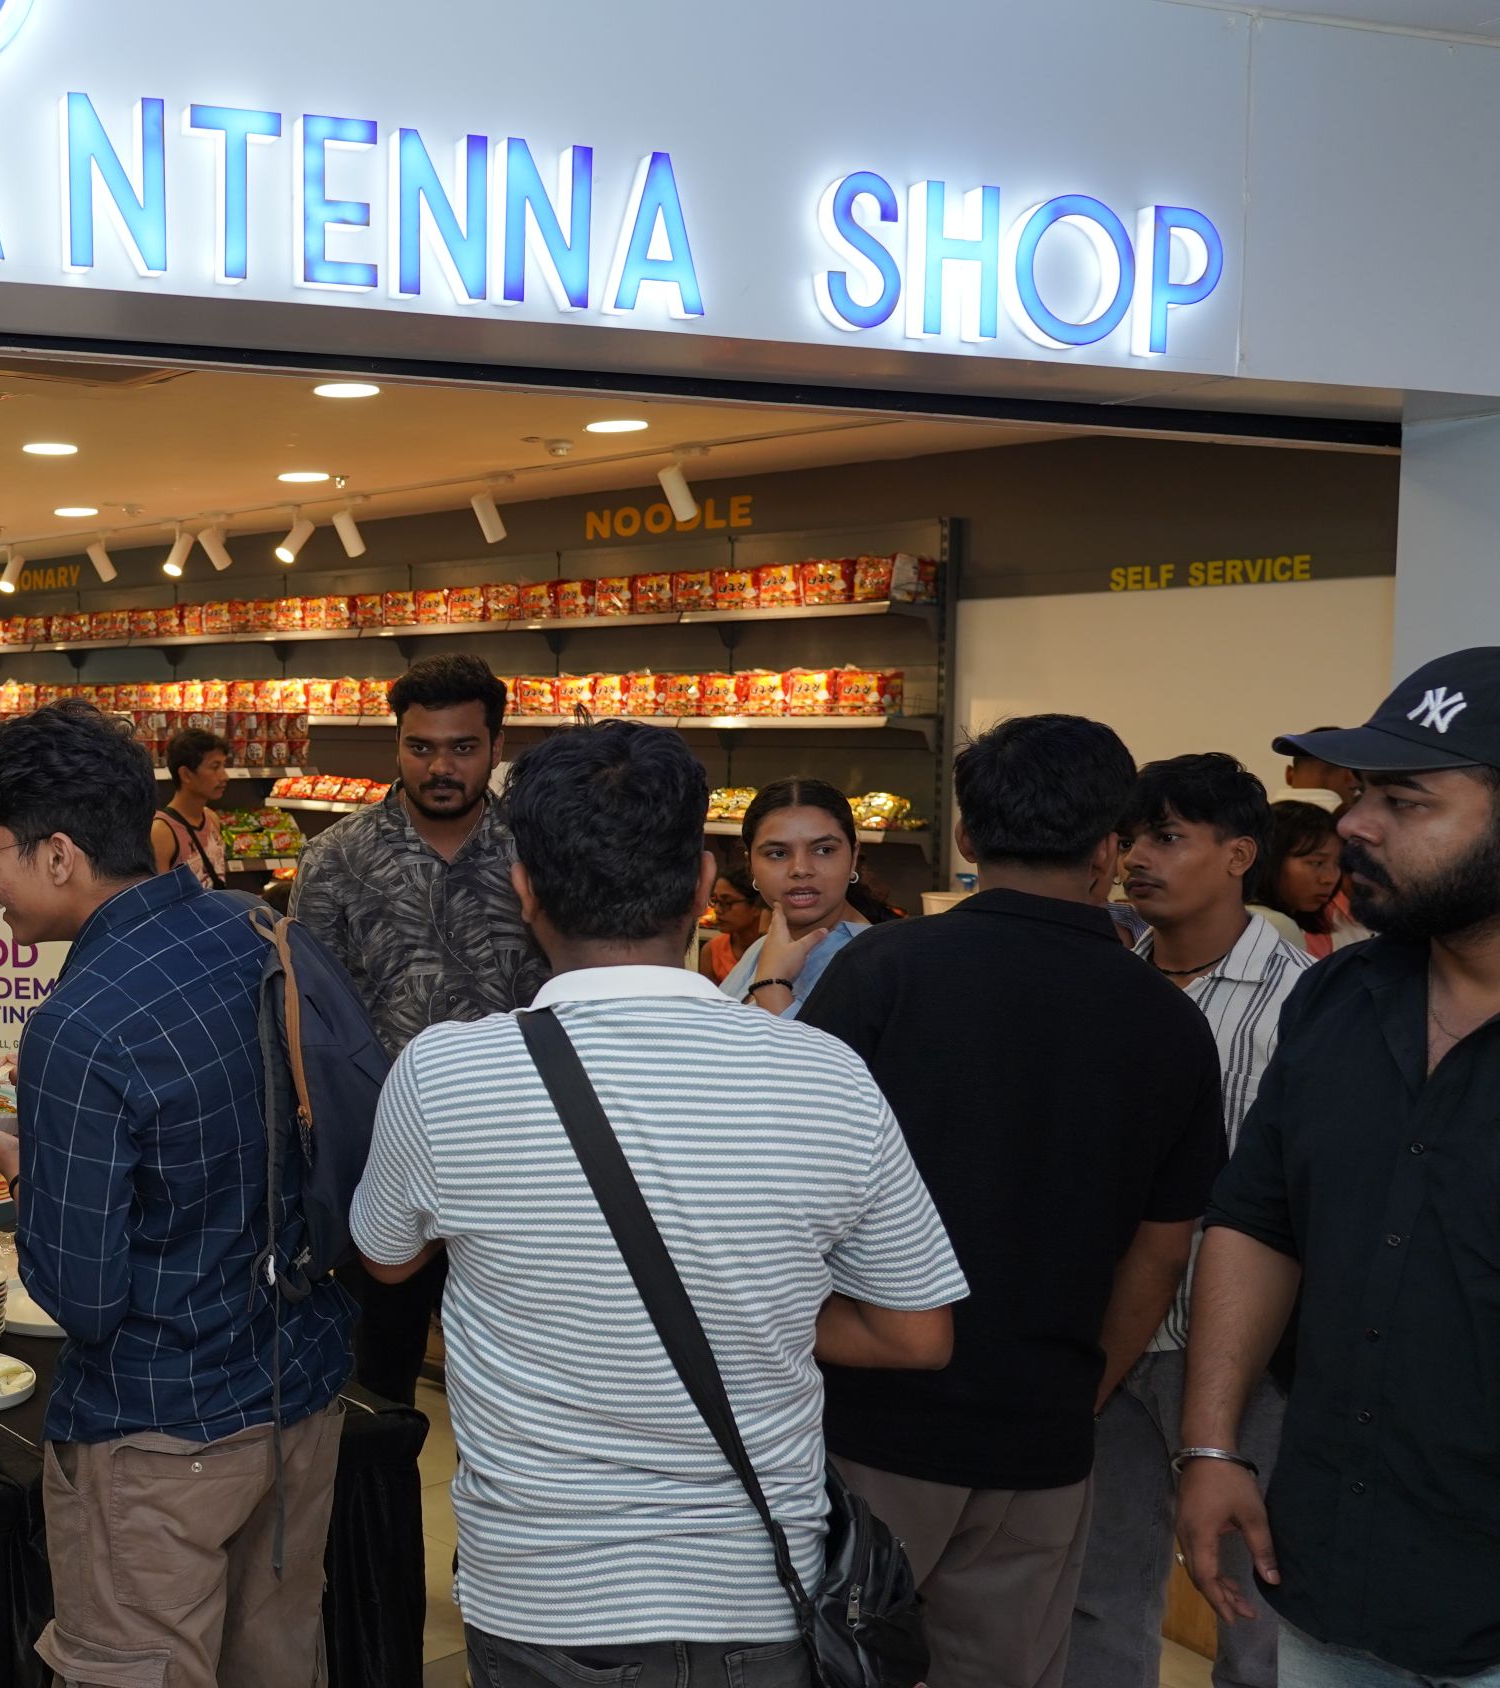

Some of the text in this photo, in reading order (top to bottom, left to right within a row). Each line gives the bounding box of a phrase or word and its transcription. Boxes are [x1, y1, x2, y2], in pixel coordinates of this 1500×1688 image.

[816, 169, 1224, 357] SHOP
[1109, 554, 1311, 592] SELF SERVICE
[1406, 686, 1468, 734] NY
